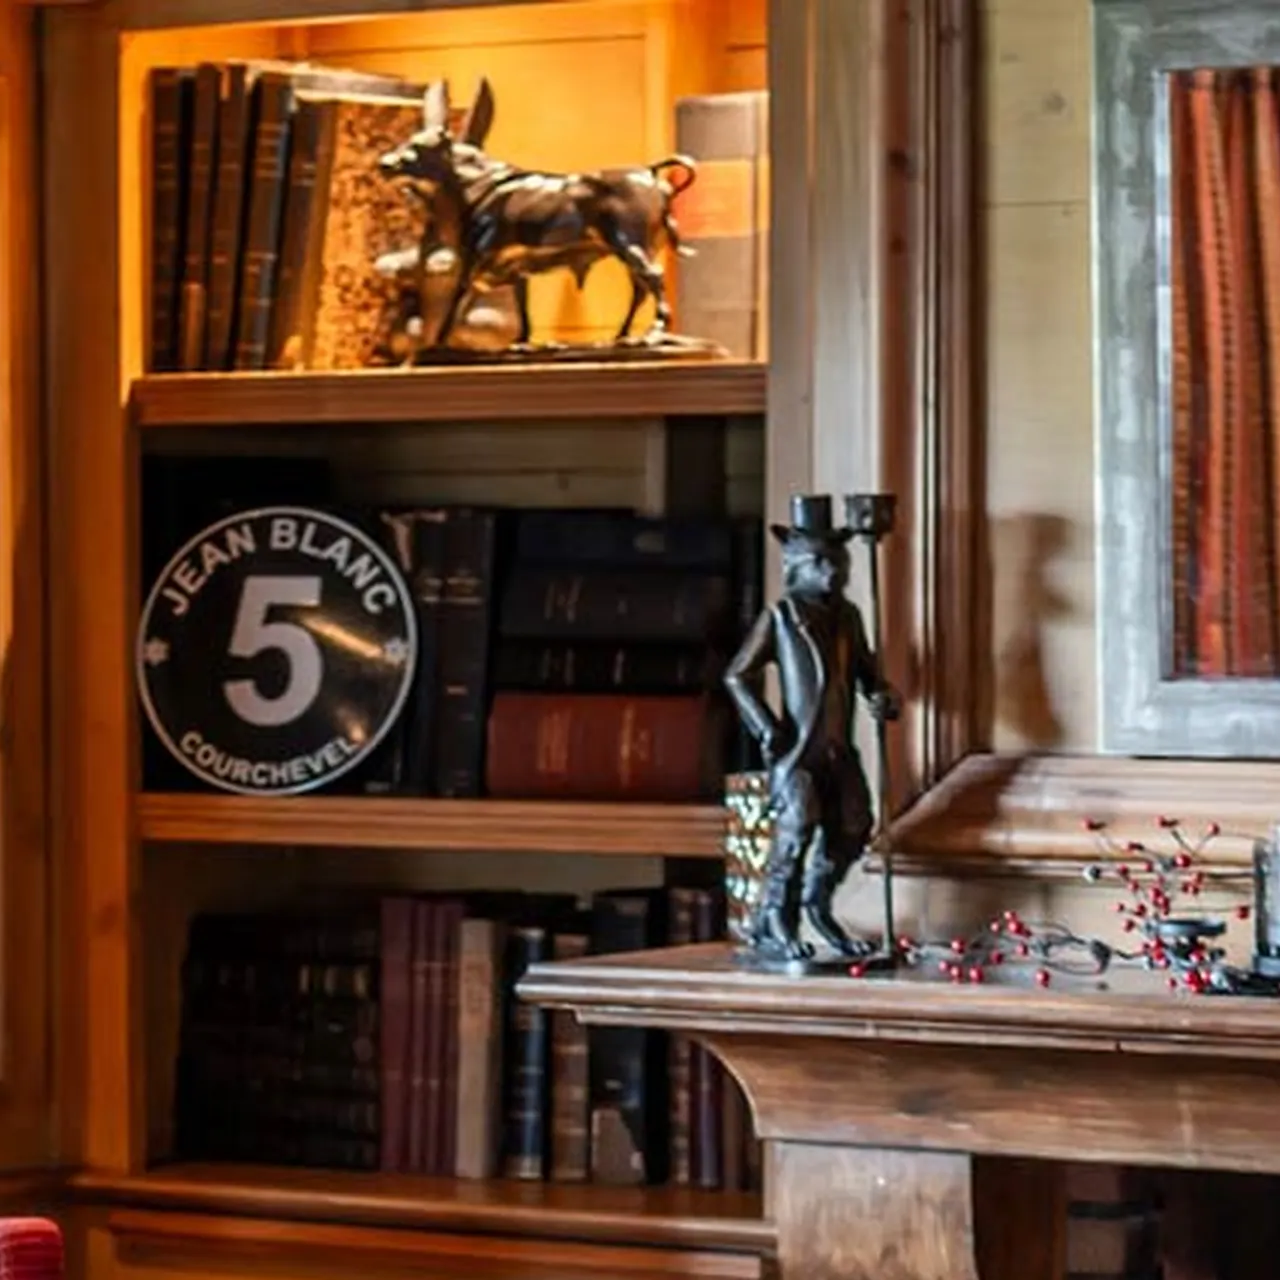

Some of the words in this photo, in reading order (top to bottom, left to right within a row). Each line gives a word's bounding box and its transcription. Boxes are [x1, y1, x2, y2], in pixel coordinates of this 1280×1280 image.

[163, 525, 257, 616] JEAN
[271, 518, 397, 613] BLANC
[224, 575, 323, 727] 5
[180, 731, 357, 785] COURCHEVEL
